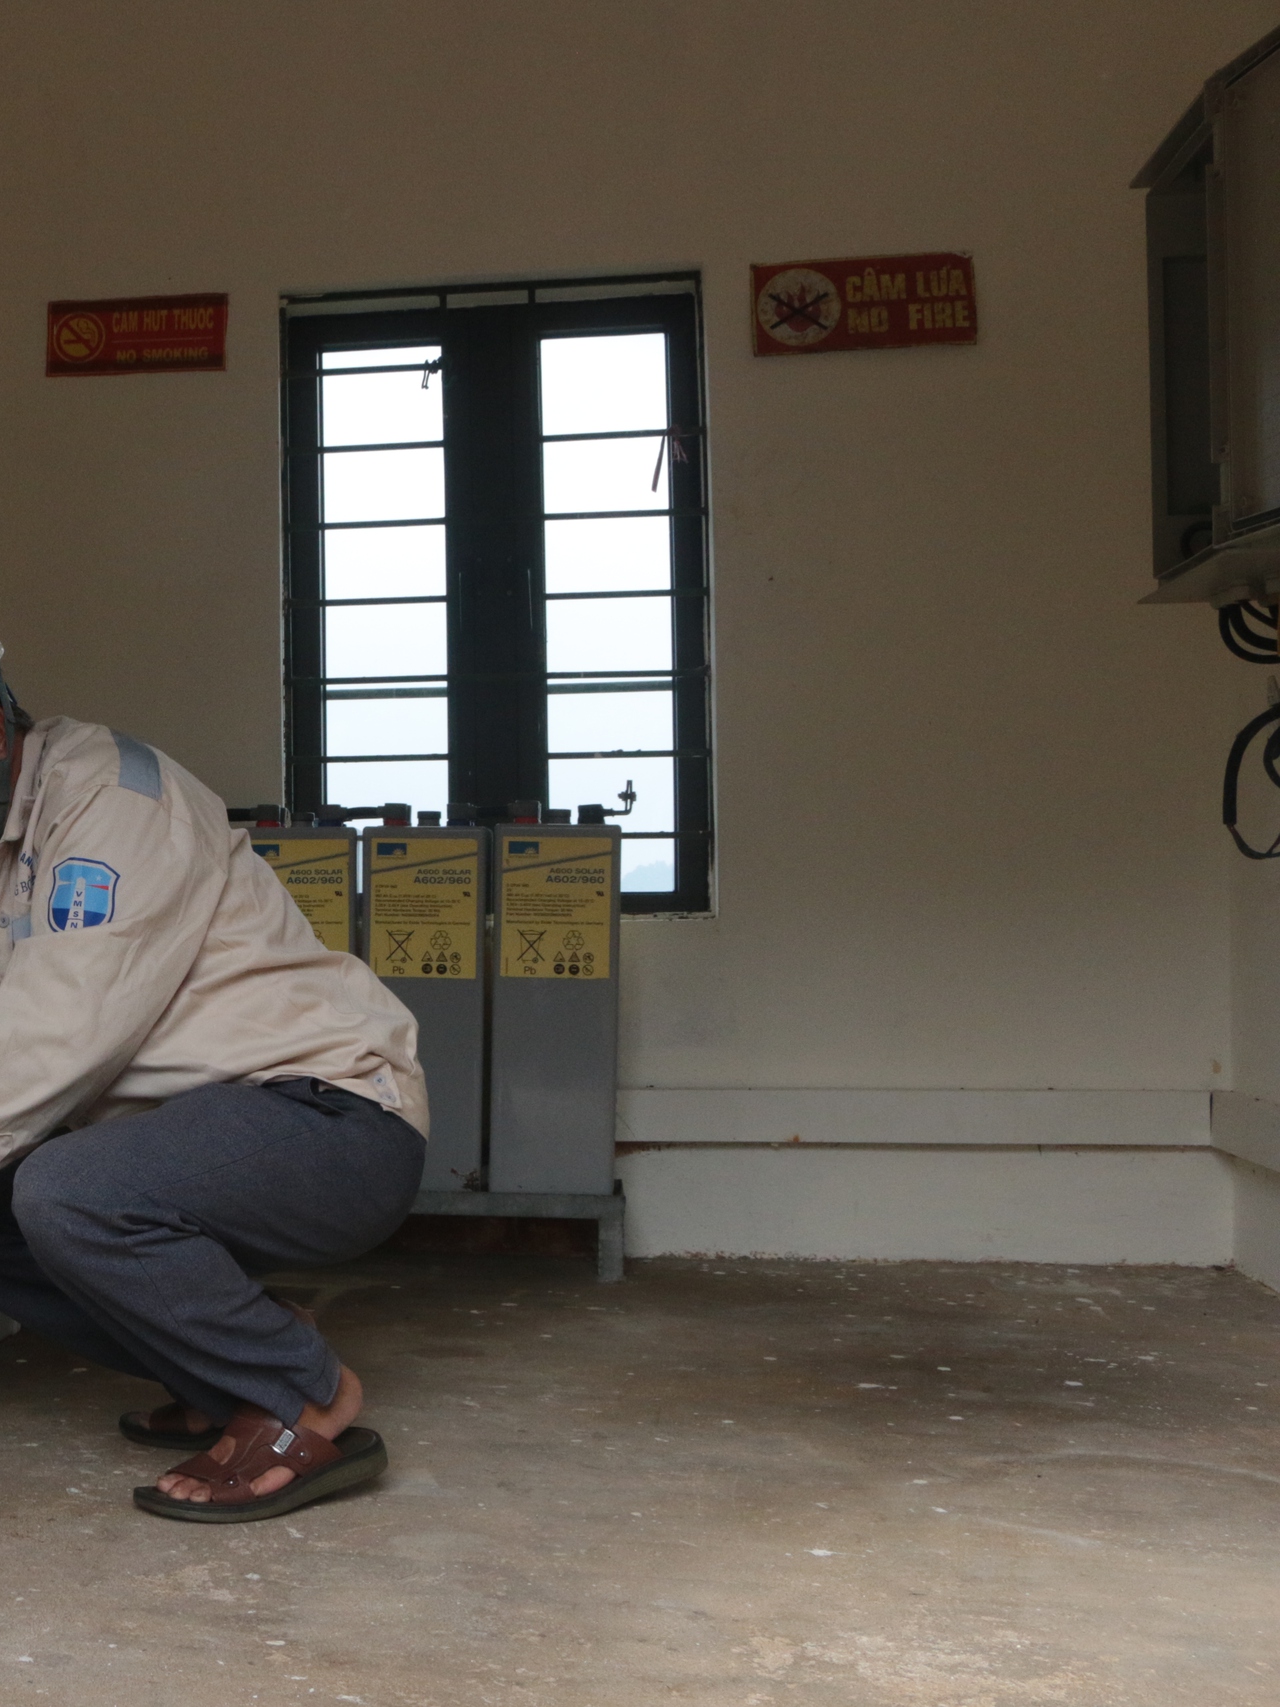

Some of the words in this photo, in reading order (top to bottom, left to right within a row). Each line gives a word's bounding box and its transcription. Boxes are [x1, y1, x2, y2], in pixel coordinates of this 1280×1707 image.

[847, 306, 889, 334] NO
[908, 301, 970, 331] FIRE
[116, 349, 137, 363] NO
[142, 346, 209, 363] SMOKING
[442, 868, 471, 876] SOLAR
[575, 867, 605, 875] SOLAR
[286, 876, 343, 884] A602/960
[413, 876, 471, 885] A602/960
[546, 875, 605, 884] A602/960
[392, 965, 405, 974] Pb
[523, 965, 536, 975] Pb
